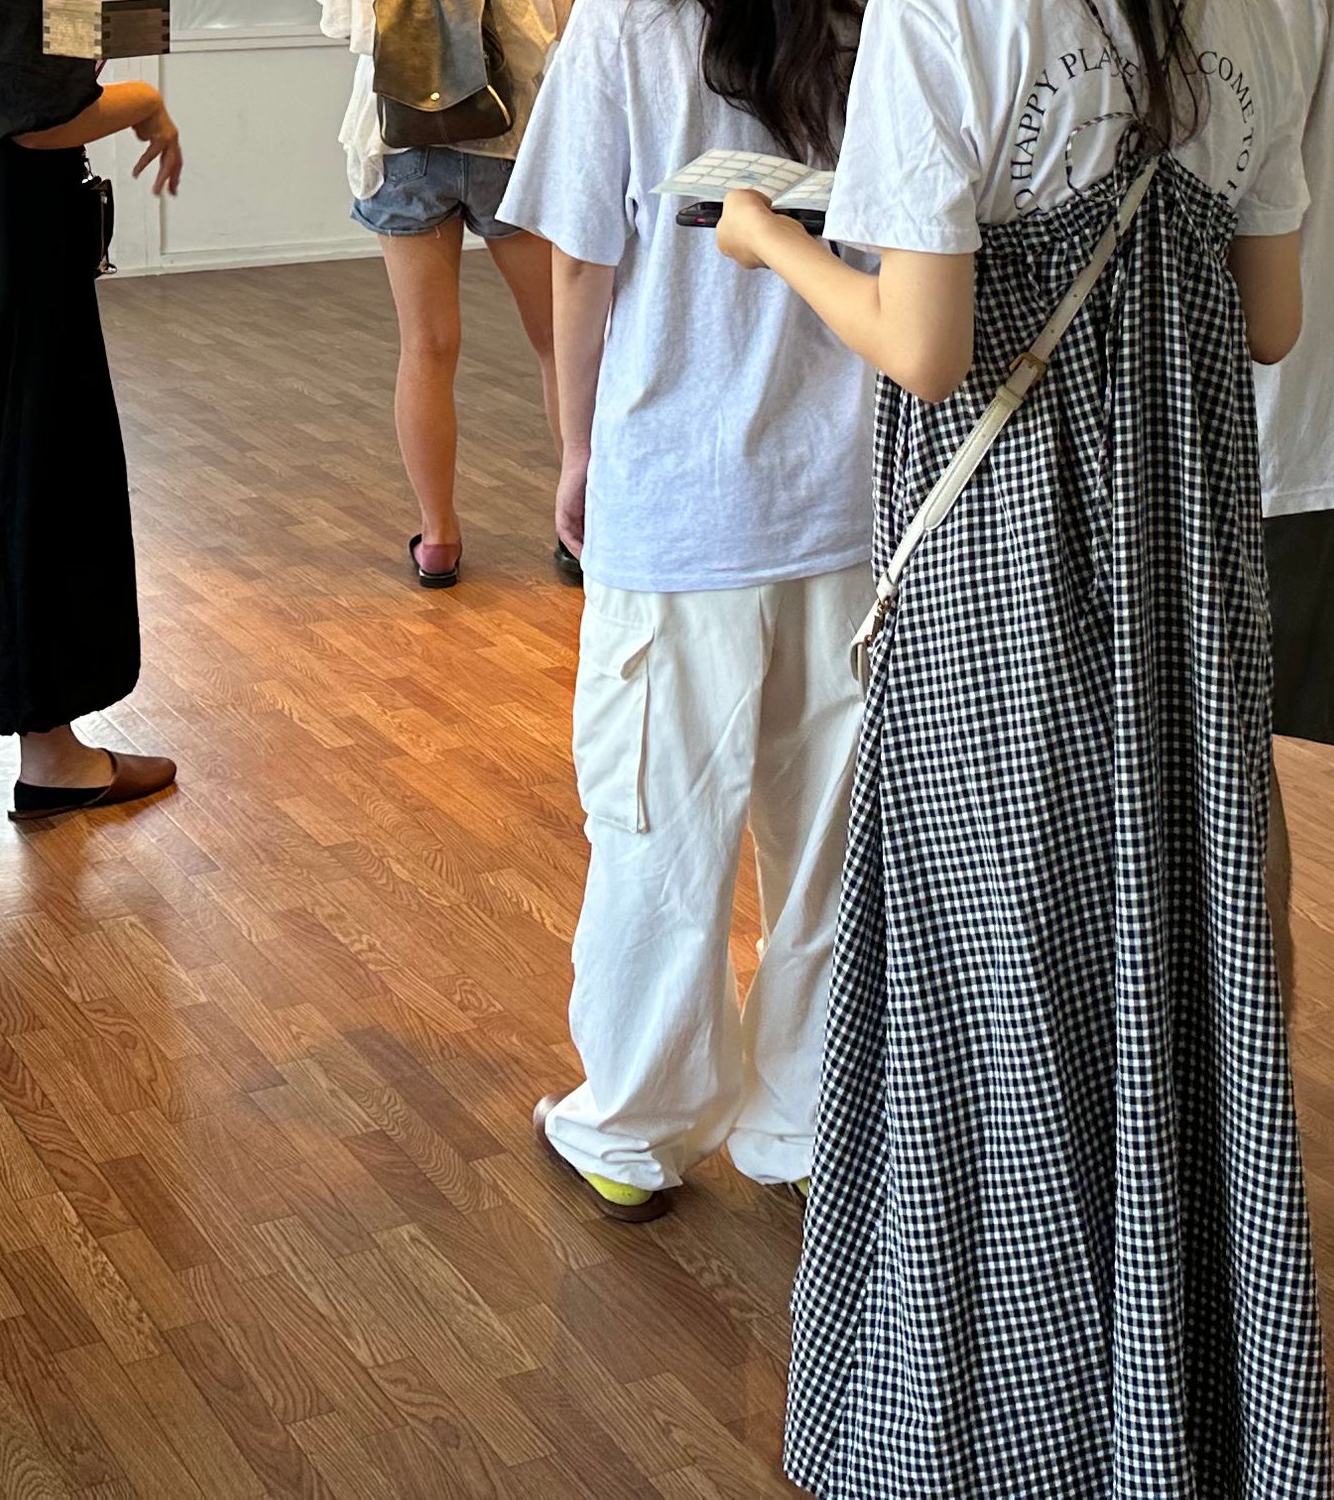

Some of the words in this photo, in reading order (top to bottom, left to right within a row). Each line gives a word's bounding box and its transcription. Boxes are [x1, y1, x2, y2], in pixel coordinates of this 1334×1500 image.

[1010, 69, 1059, 182] HAPPY
[1183, 50, 1256, 124] COME
[1235, 126, 1255, 172] TO
